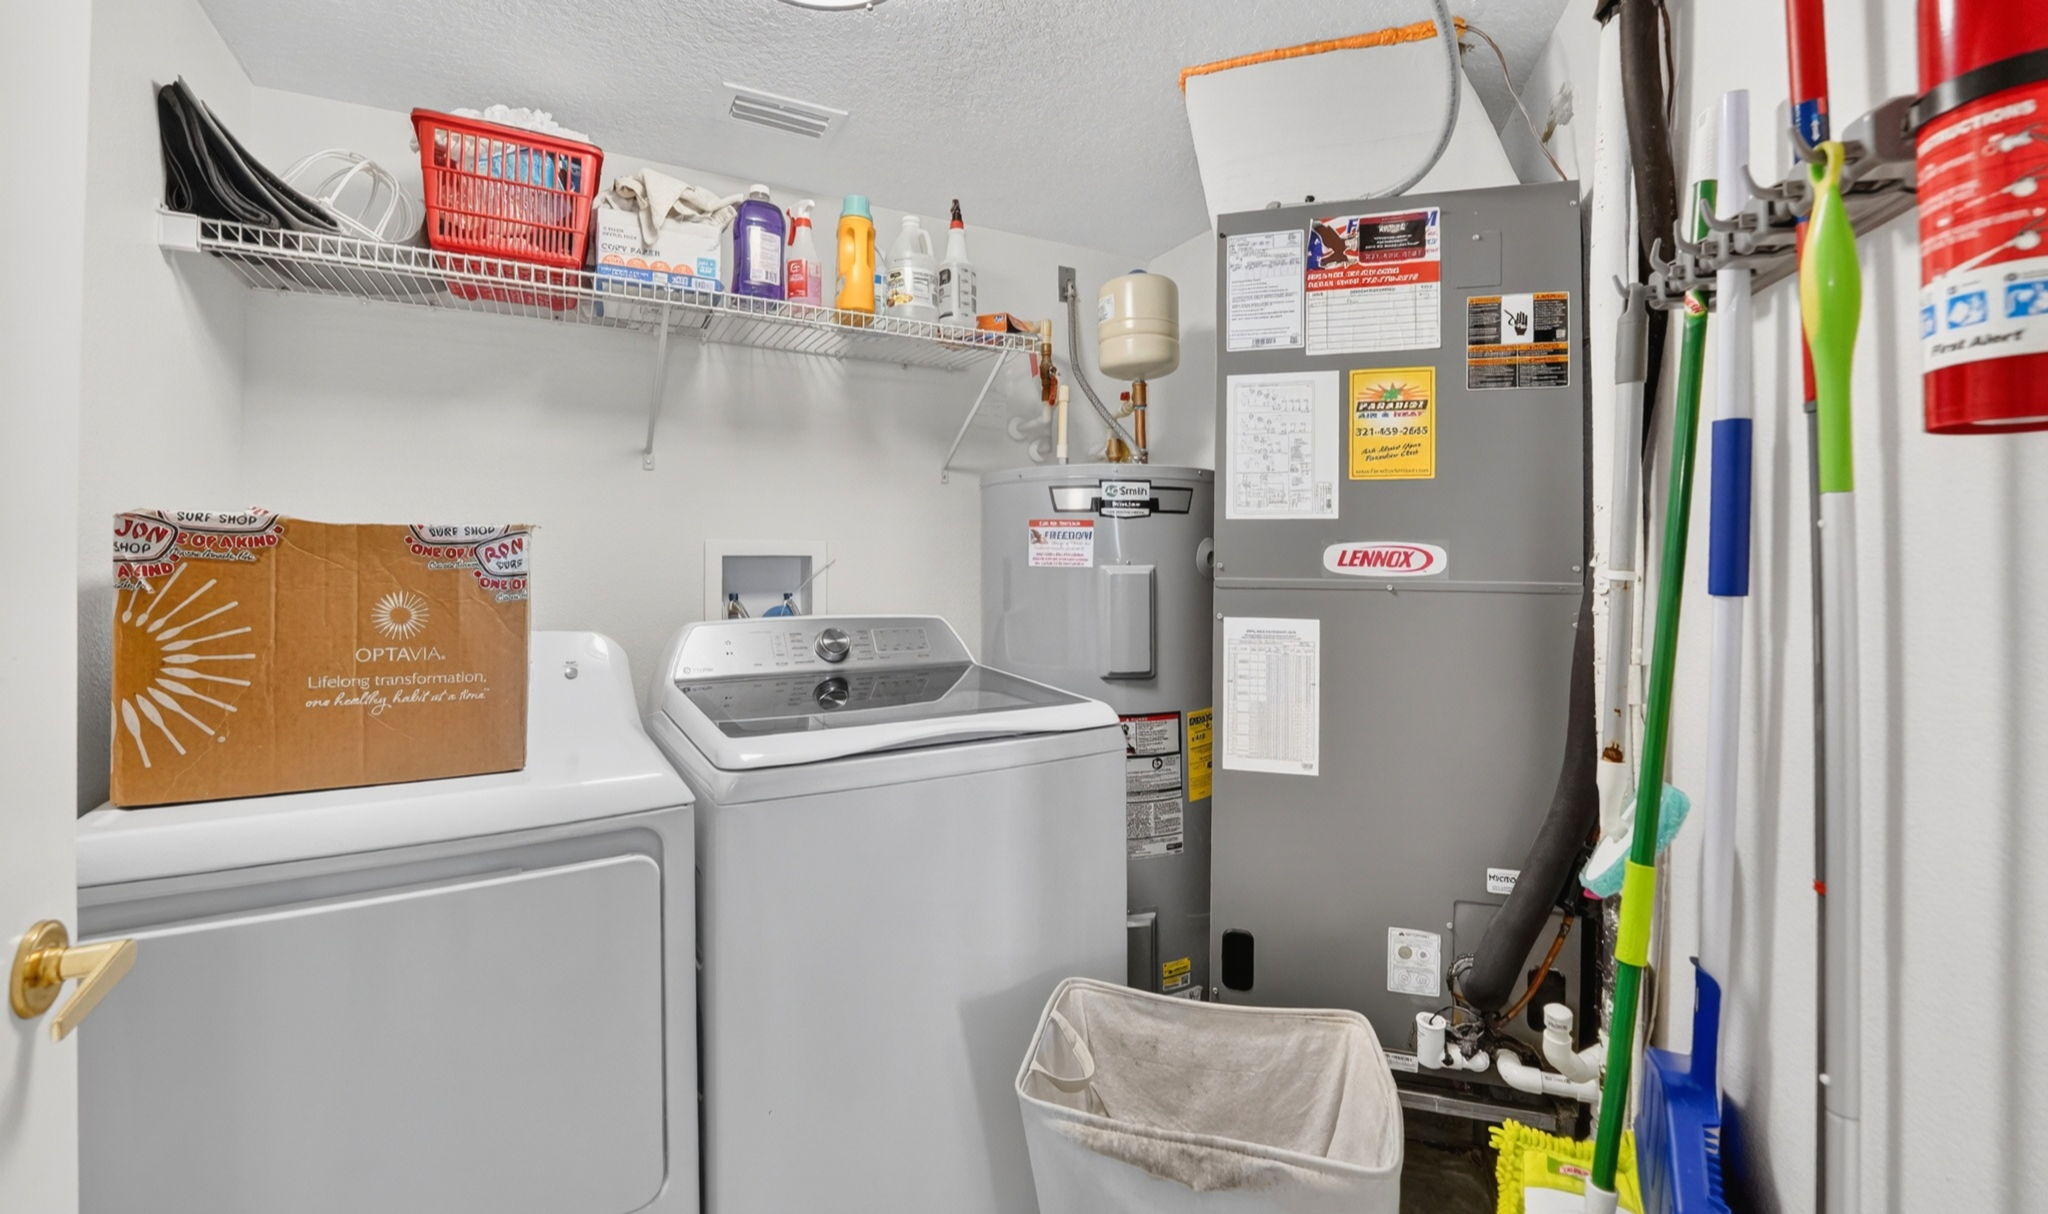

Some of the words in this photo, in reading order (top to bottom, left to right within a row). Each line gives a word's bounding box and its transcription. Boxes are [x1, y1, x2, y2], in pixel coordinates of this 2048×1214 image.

[1119, 486, 1147, 497] Smith
[177, 511, 212, 523] SURF
[219, 513, 258, 525] SHOP
[114, 519, 169, 543] JON
[235, 534, 279, 549] KIND
[411, 544, 441, 557] ONE
[484, 537, 523, 563] RON
[1337, 550, 1415, 568] LENNOX
[480, 577, 507, 590] ONE
[308, 675, 370, 690] Lifelong
[305, 699, 329, 708] one
[333, 690, 392, 716] healthy
[392, 688, 431, 704] habit
[431, 691, 446, 703] at
[447, 693, 457, 701] a
